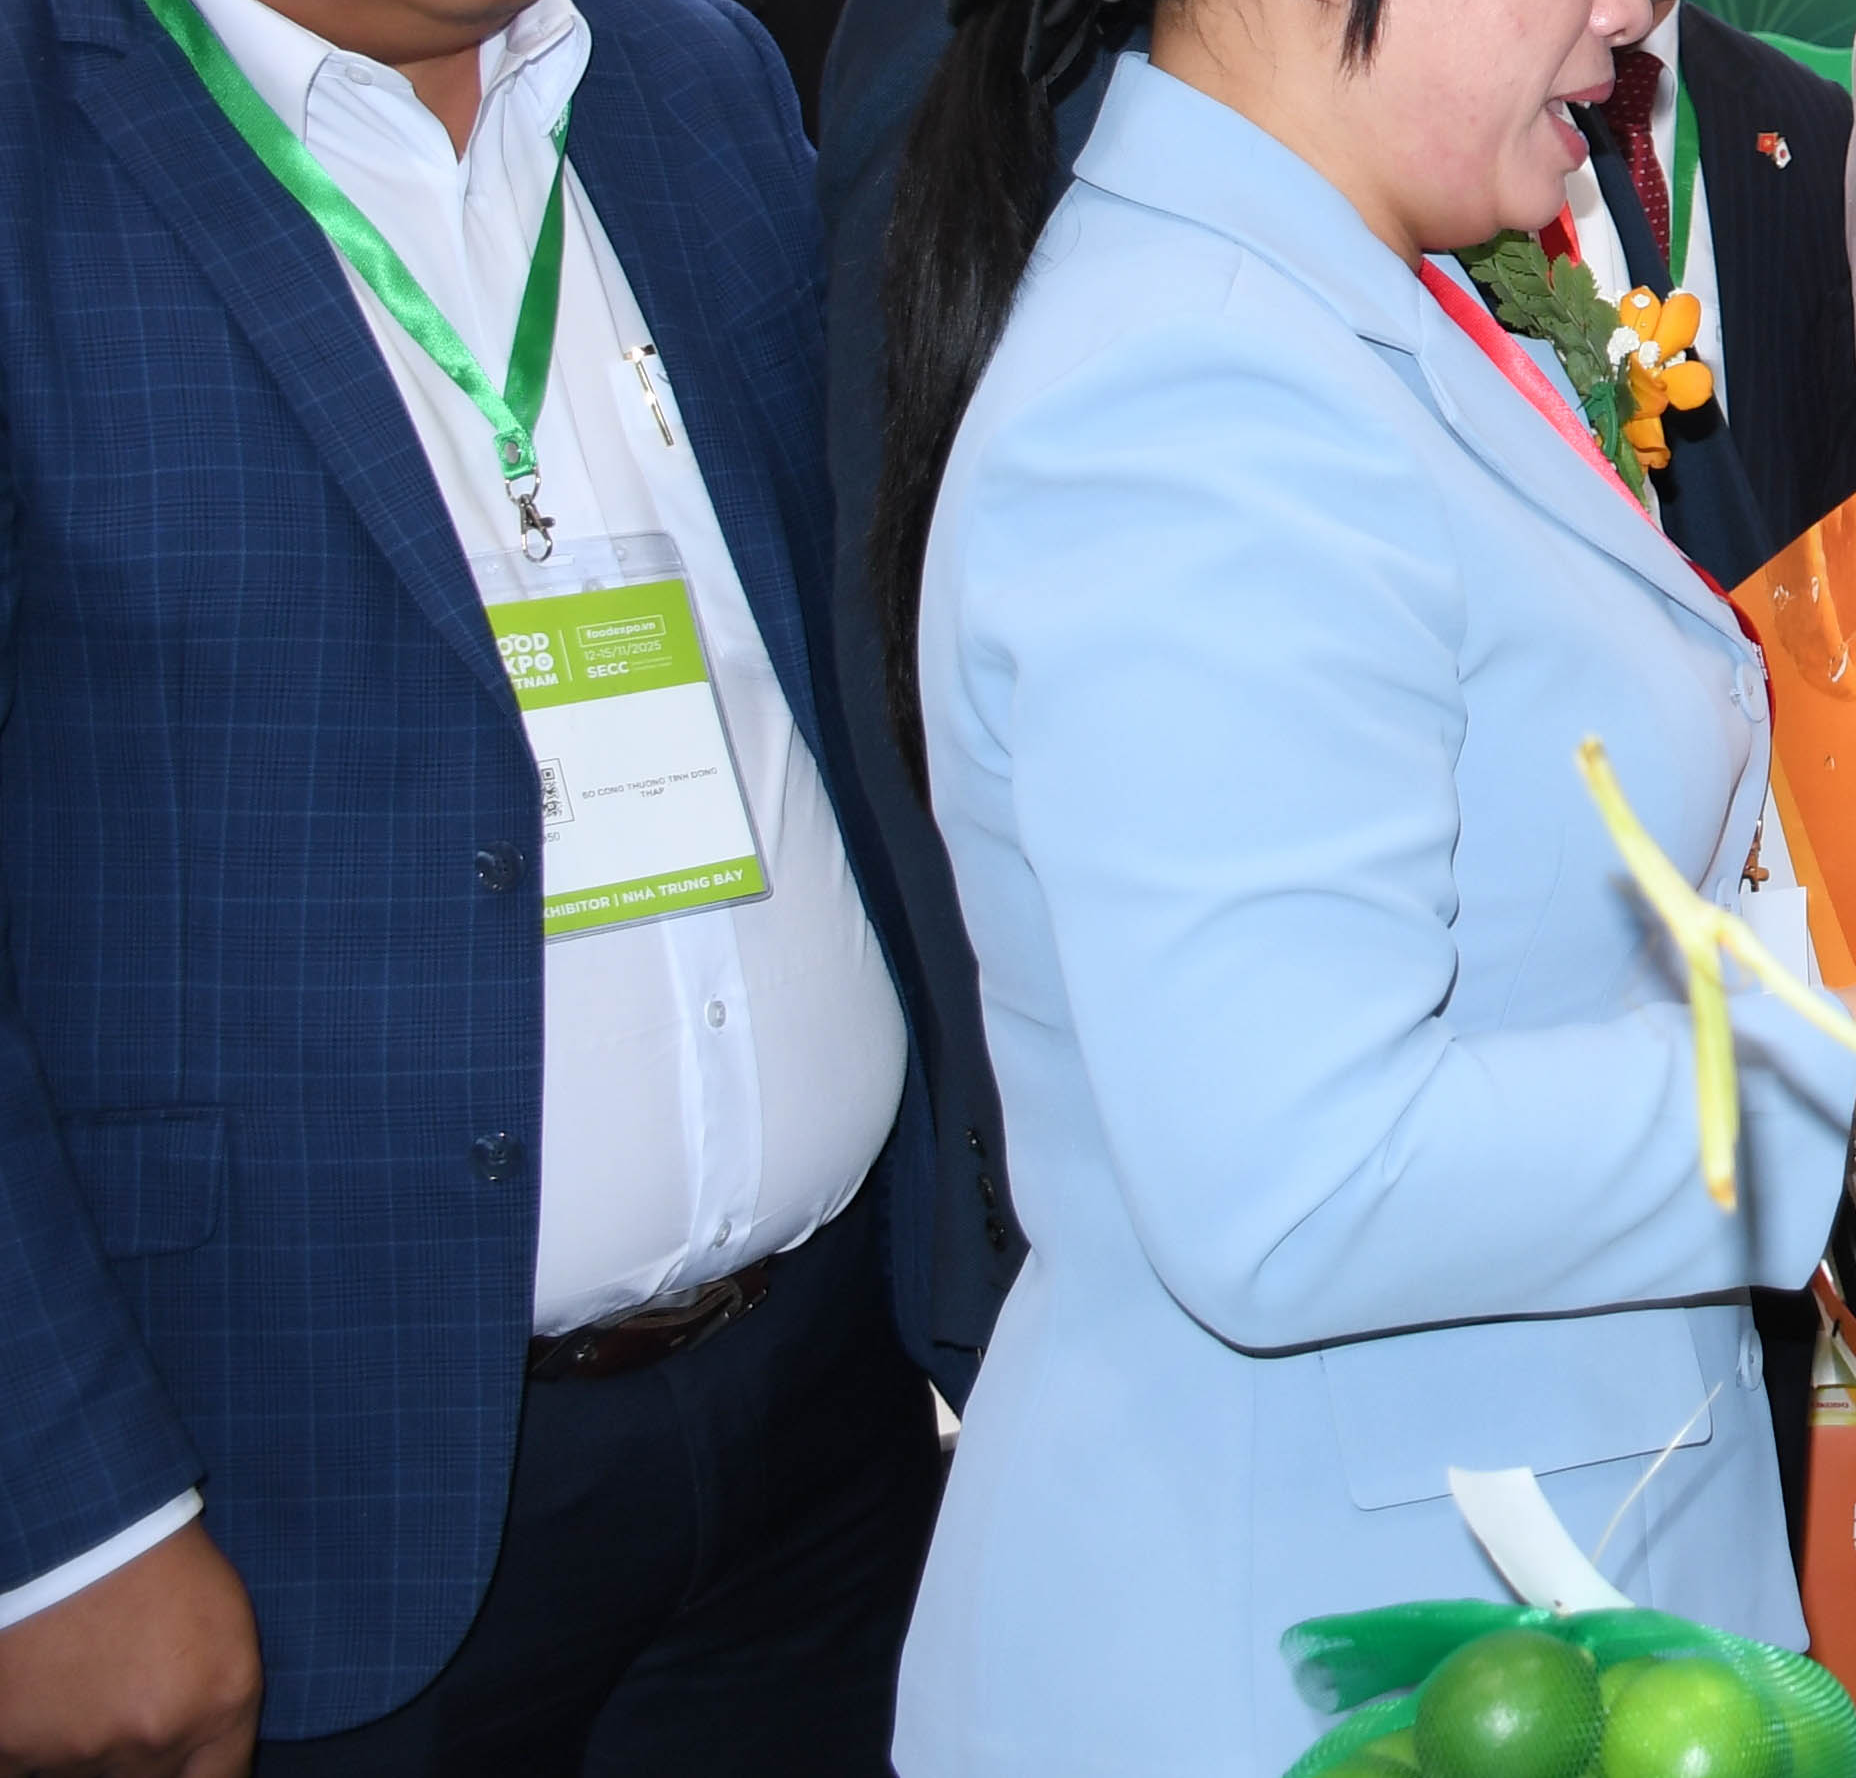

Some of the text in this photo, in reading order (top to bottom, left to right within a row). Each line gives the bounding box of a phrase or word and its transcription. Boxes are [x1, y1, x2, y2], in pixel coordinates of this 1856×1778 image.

[585, 621, 657, 640] foodexpo.vn
[498, 631, 550, 657] OOD
[505, 652, 554, 676] XPO
[586, 661, 630, 679] SECC
[516, 672, 559, 690] TNAM
[543, 831, 561, 844] 50
[544, 896, 611, 919] XHIBITOR
[657, 876, 711, 897] TRUNG
